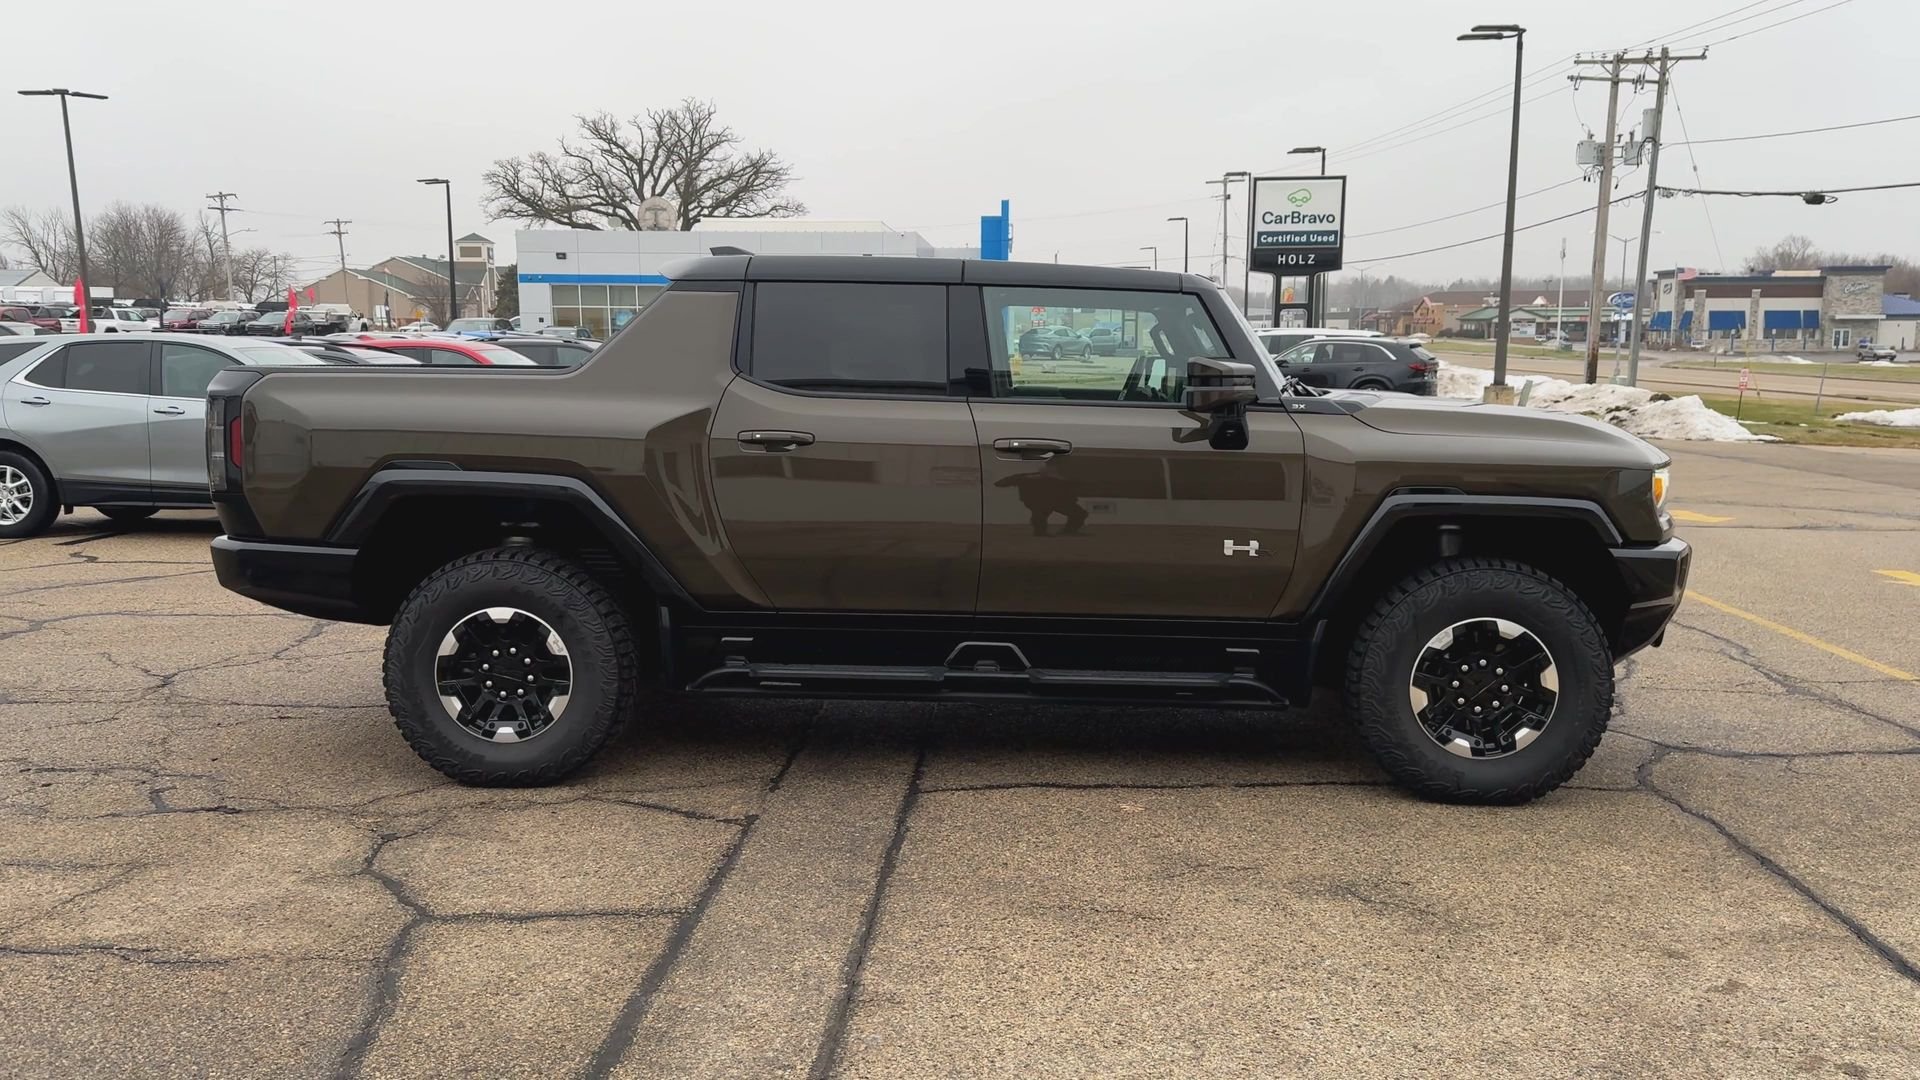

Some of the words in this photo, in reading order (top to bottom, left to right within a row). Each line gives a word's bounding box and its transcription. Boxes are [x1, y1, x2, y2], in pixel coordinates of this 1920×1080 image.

[1262, 211, 1336, 225] CarBravo
[1260, 234, 1307, 243] Certified
[1309, 234, 1335, 242] Used
[1277, 254, 1316, 265] HOLZ
